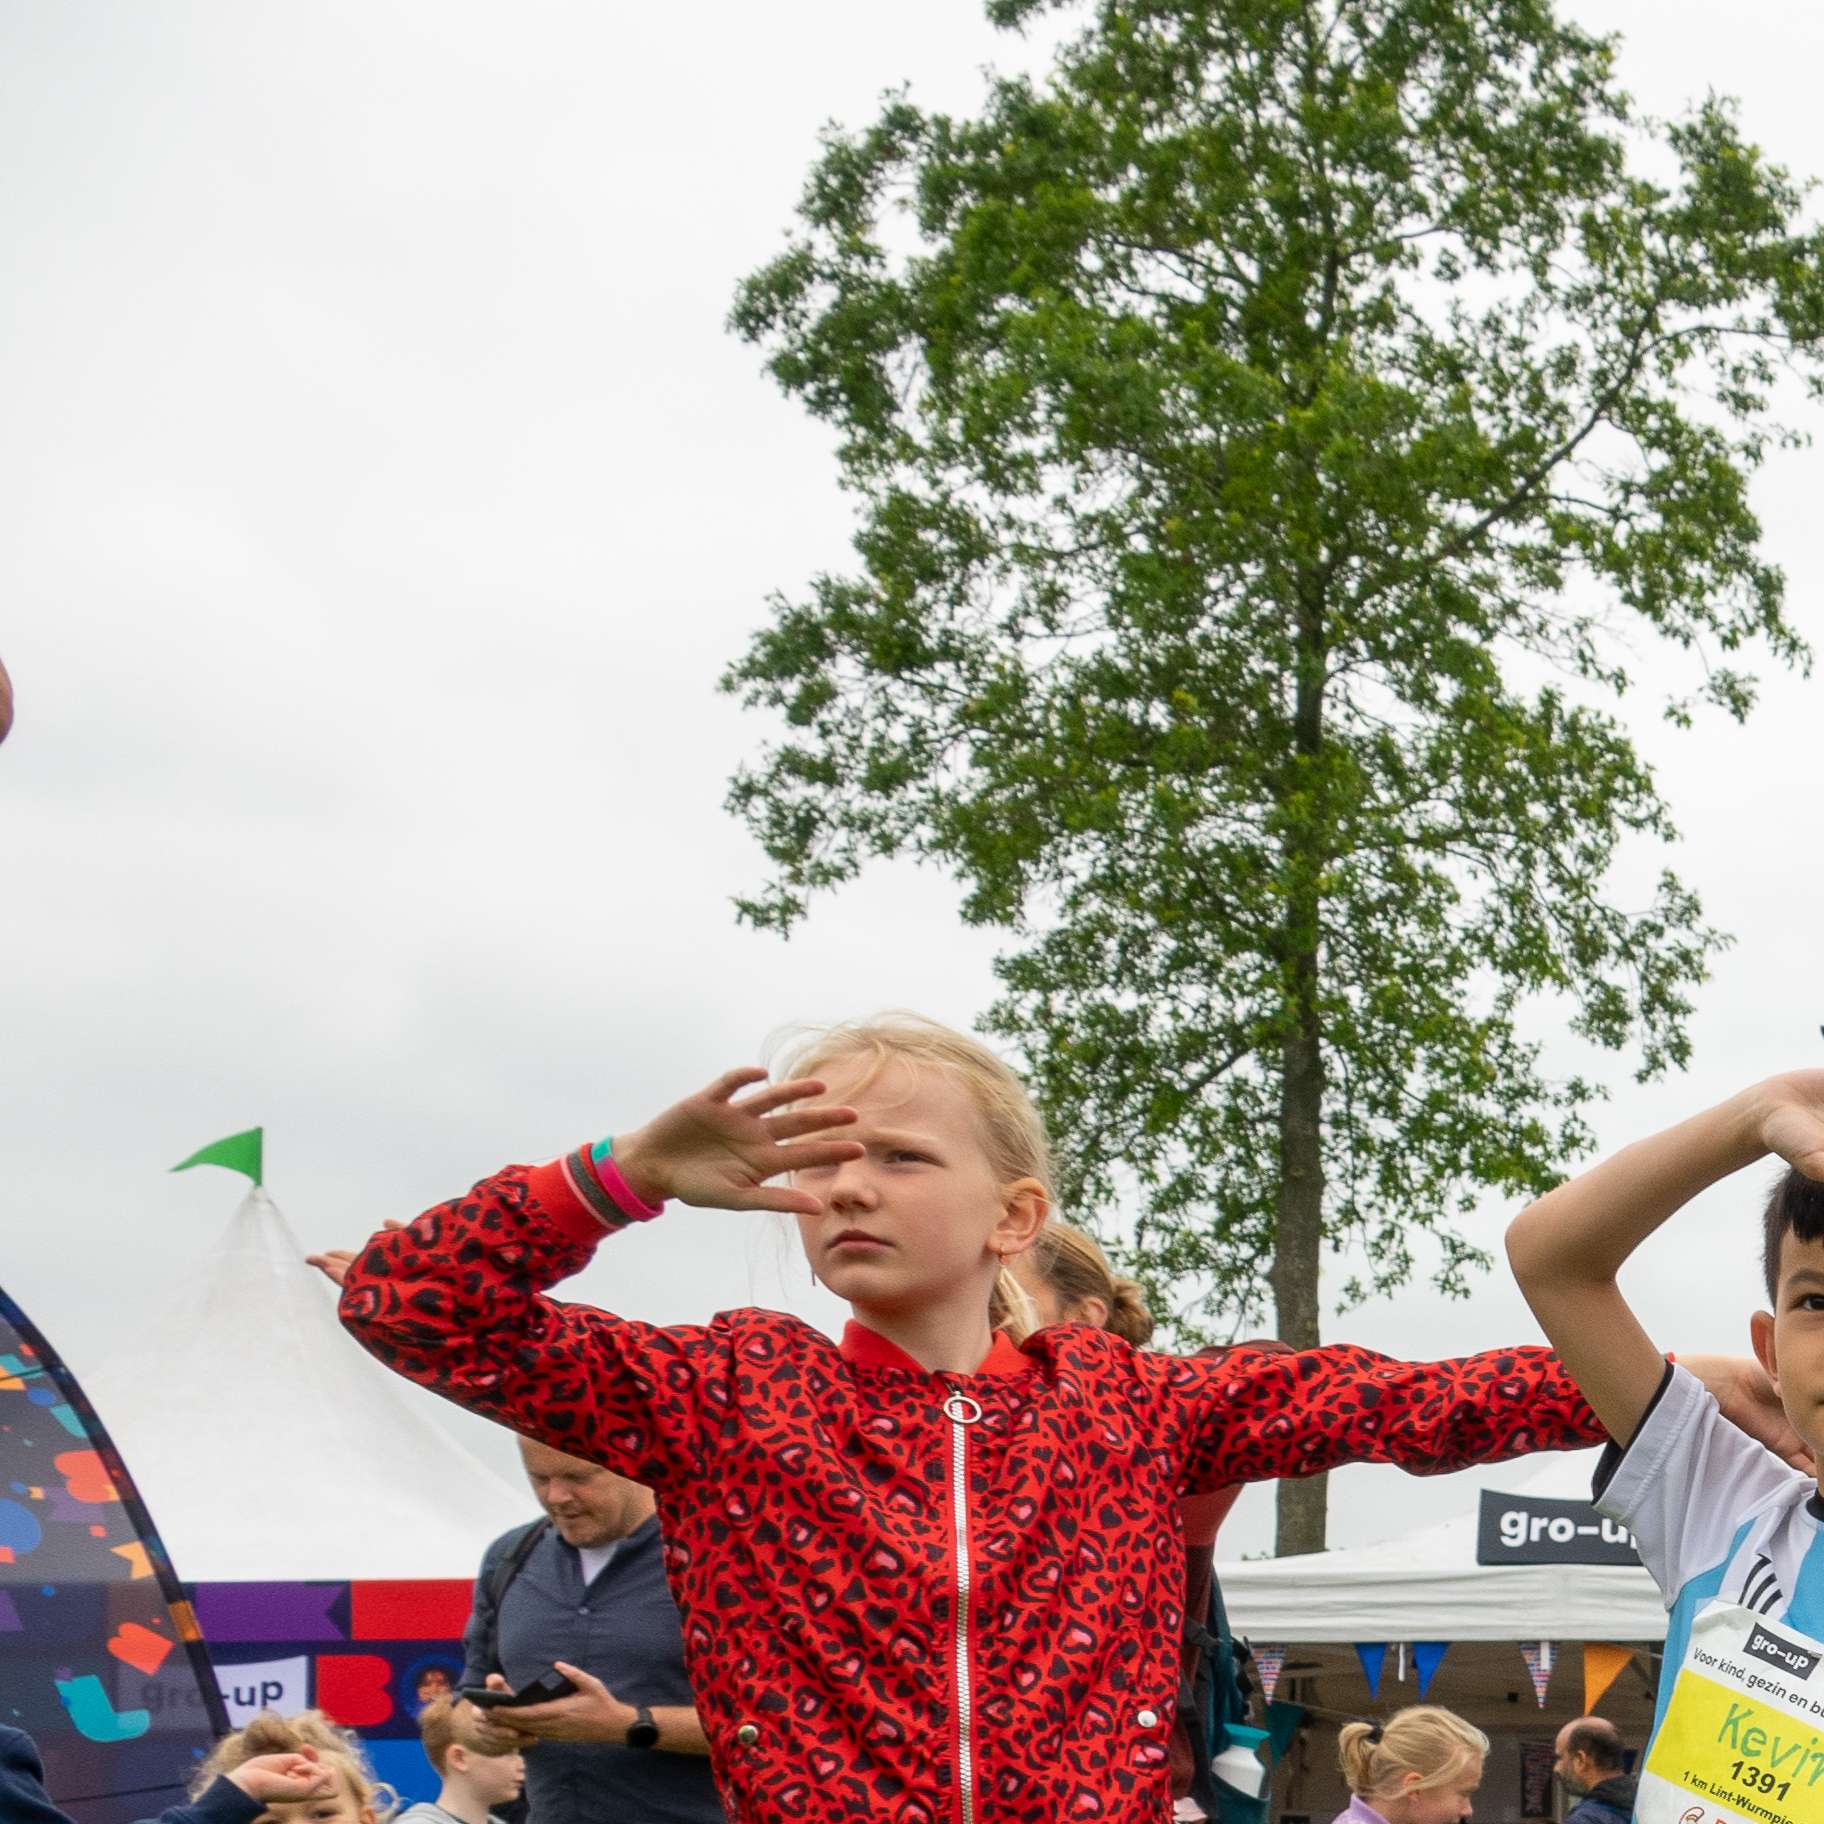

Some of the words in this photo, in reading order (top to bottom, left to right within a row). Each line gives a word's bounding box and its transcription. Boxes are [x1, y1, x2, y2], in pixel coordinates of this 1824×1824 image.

[1750, 1633, 1810, 1671] gro-up
[1693, 1647, 1718, 1667] Voor
[1717, 1656, 1746, 1684] kind,
[1747, 1672, 1787, 1700] gezin
[1788, 1691, 1808, 1709] en
[1683, 1770, 1691, 1783] 1
[1691, 1773, 1708, 1791] km
[1730, 1760, 1792, 1802] 1391
